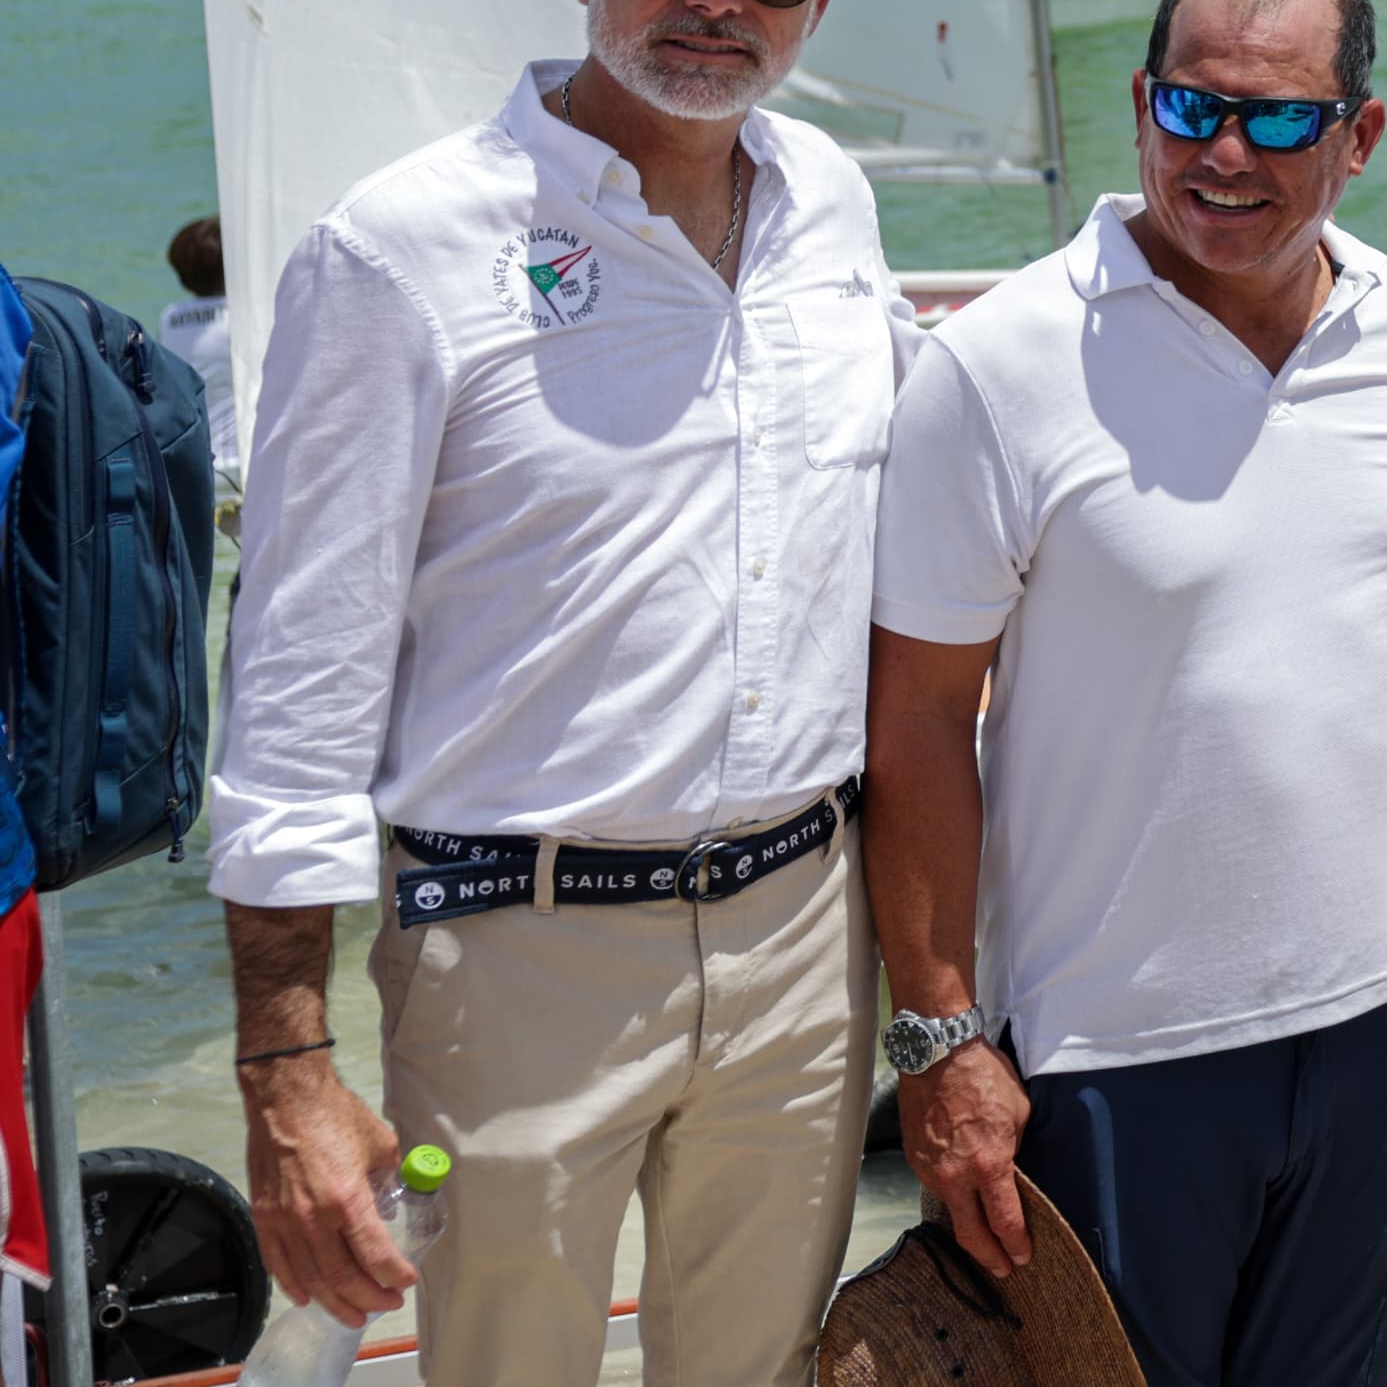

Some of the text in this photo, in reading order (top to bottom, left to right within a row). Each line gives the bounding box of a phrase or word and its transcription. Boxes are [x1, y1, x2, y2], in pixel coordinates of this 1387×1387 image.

[500, 241, 518, 258] DE
[516, 227, 580, 249] YUCATAN
[493, 258, 509, 295] YATES
[518, 310, 550, 328] CLUB
[762, 786, 855, 862] NORTH SILS
[459, 874, 637, 900] NORT SAILS
